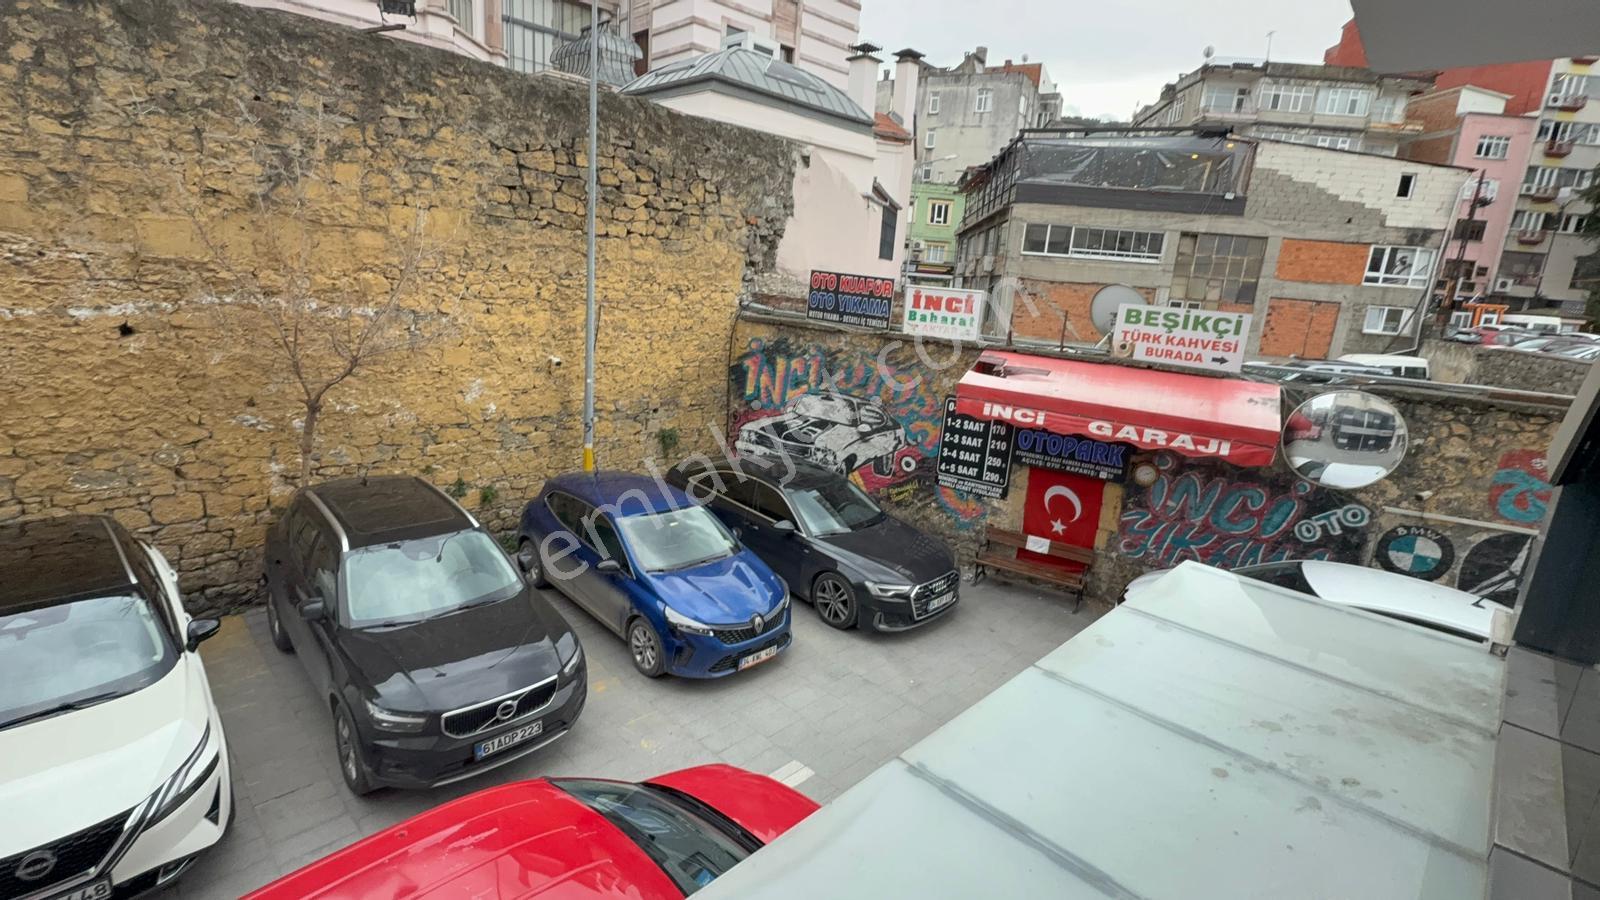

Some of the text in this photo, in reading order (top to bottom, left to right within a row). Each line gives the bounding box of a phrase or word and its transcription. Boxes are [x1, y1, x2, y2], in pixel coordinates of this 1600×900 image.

[811, 272, 837, 291] OTO
[809, 290, 889, 318] OTO YIKAMA
[912, 288, 974, 314] İNCİ
[908, 310, 975, 327] Baharat
[1124, 308, 1243, 339] BEŞİKÇİ
[1121, 329, 1239, 353] TÜRK KAHVESİ
[1145, 347, 1203, 363] BURADA
[947, 417, 1006, 436] 1-2 SAAT 170
[944, 432, 1007, 451] 2-3 SAAT 210
[1018, 429, 1126, 467] OTOPARK
[1087, 421, 1231, 456] GARAJI
[942, 447, 1001, 467] 3-4 SAAT 250
[940, 462, 1000, 483] 4-5 SAAT 290
[1294, 504, 1370, 542] OTO
[1396, 527, 1441, 540] BMW
[520, 723, 540, 739] 223
